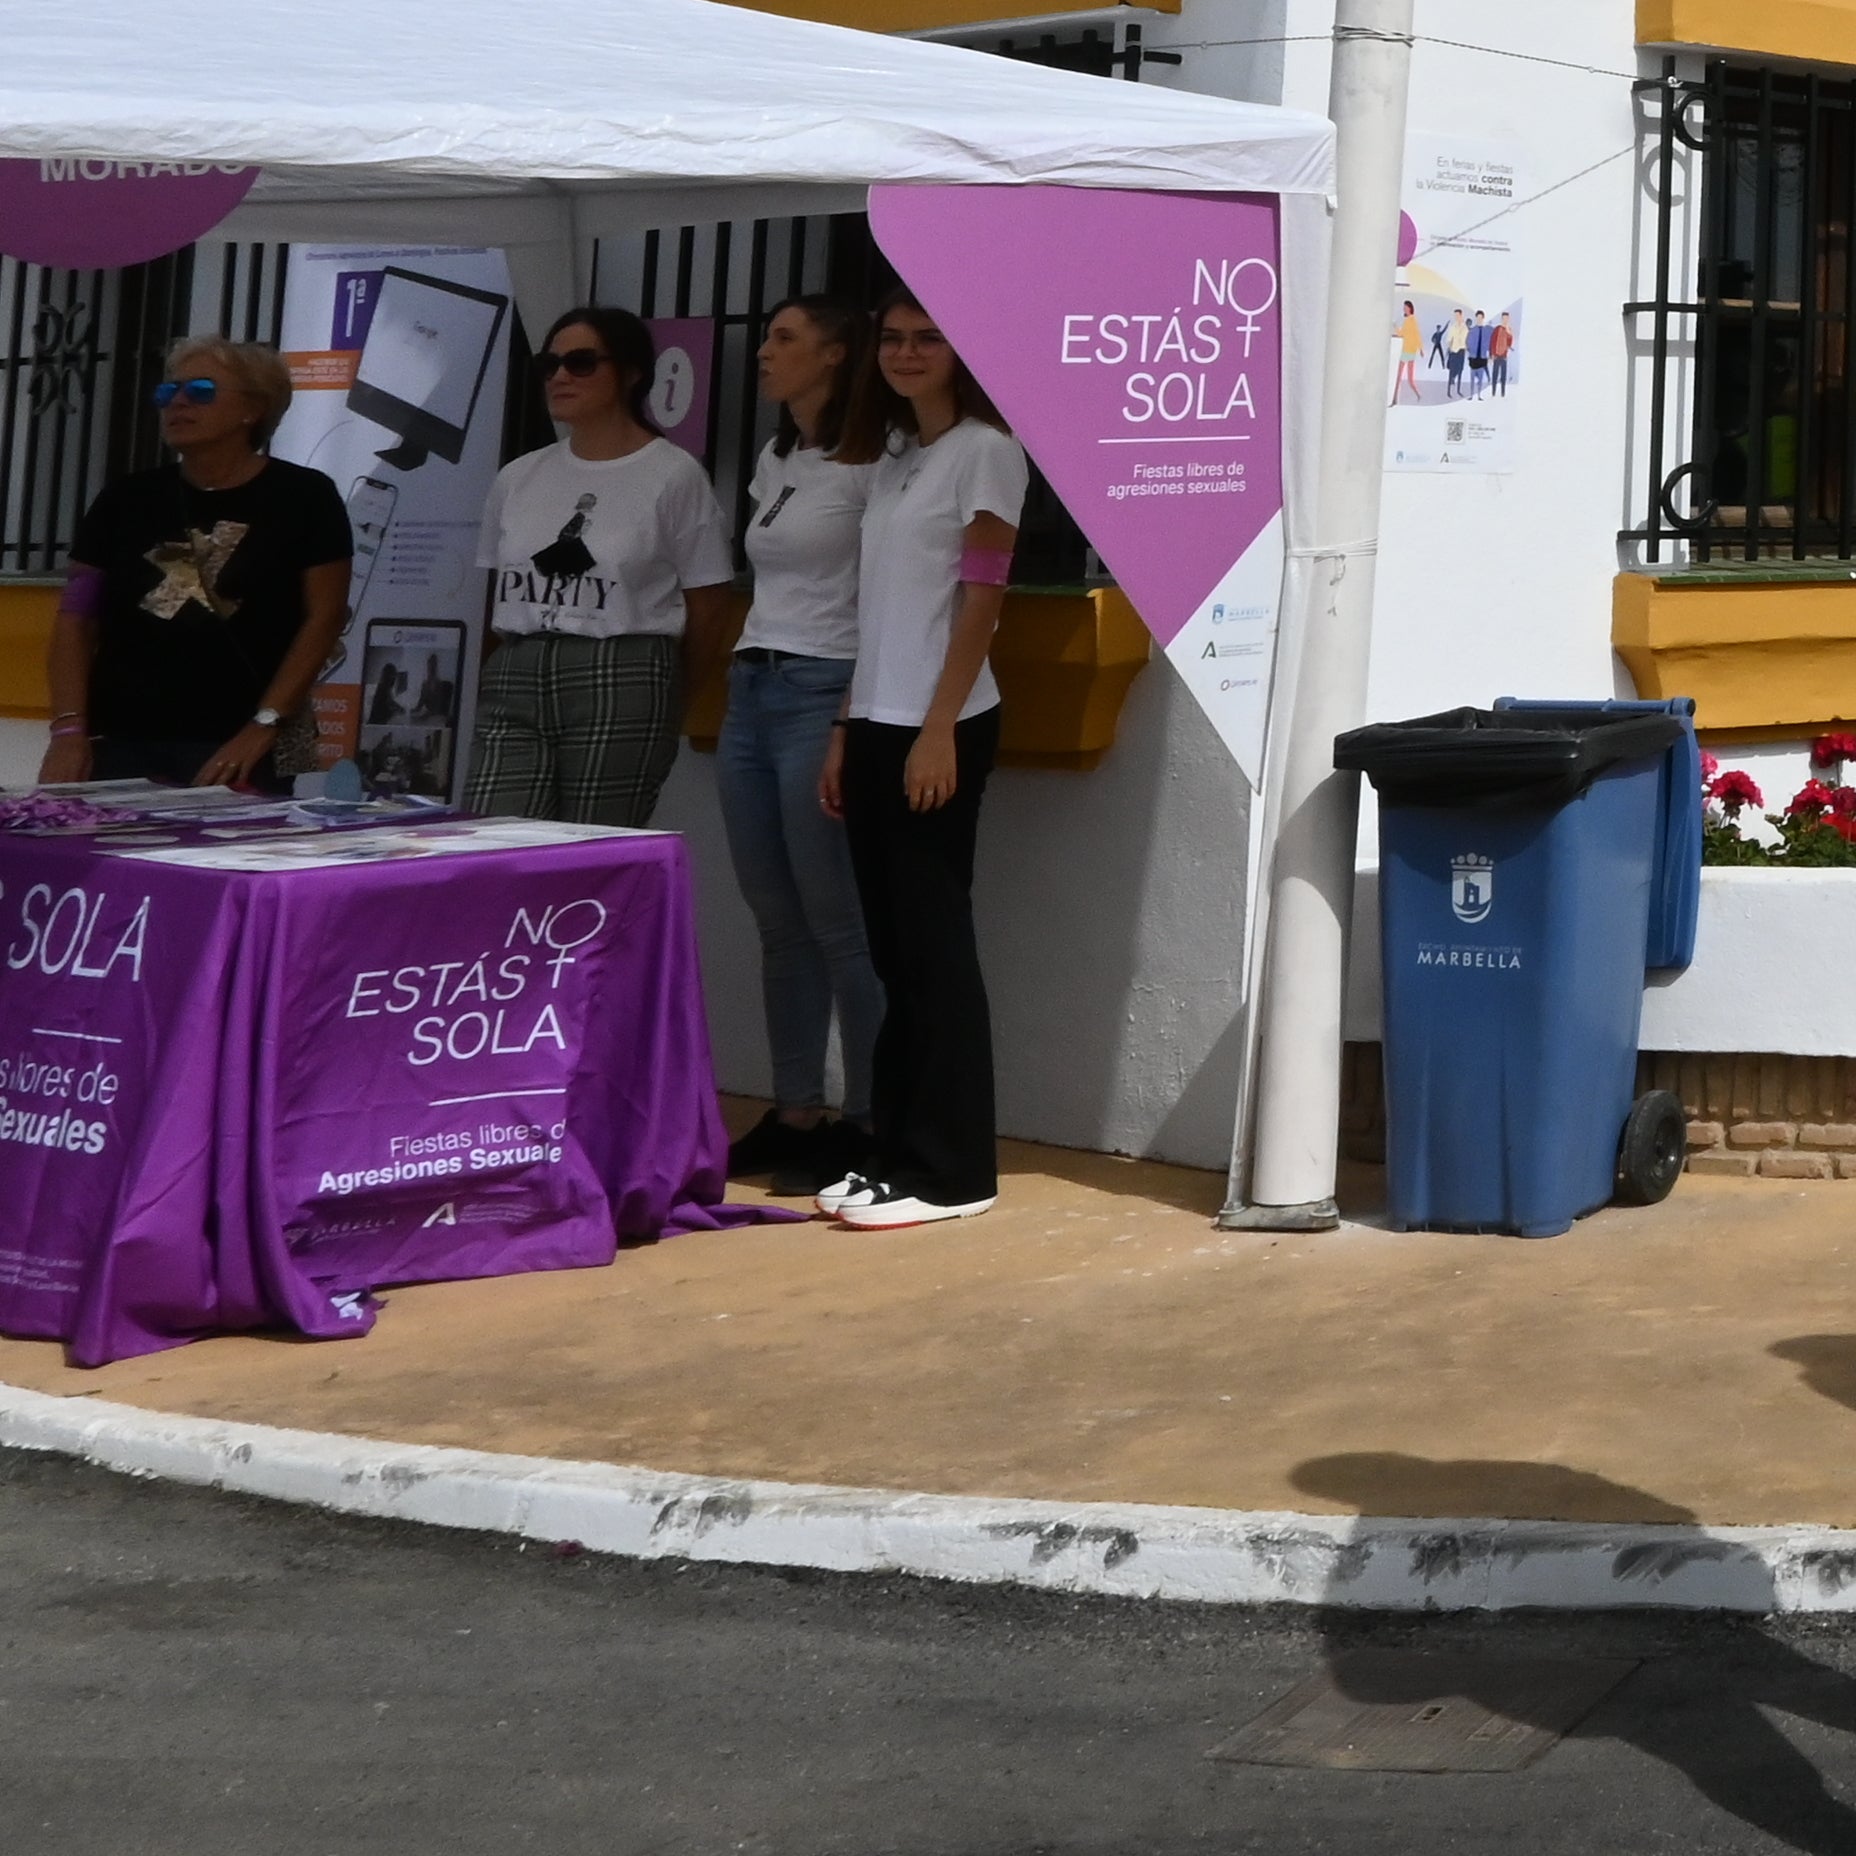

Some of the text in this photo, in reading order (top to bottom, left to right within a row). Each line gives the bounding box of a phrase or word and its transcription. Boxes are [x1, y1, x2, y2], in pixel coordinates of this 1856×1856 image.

[1468, 184, 1513, 197] Machista
[1481, 174, 1513, 186] contra
[1193, 258, 1278, 316] NO
[1061, 307, 1222, 364] ESTÁS
[1122, 372, 1256, 423] SOLA
[1107, 478, 1247, 500] agresiones sexuales
[1133, 461, 1245, 479] Fiestas libres de
[7, 883, 151, 982] SOLA
[504, 899, 608, 949] NO
[346, 951, 531, 1019] ESTÁS
[1416, 951, 1521, 969] MARBELLA
[407, 1003, 566, 1066] SOLA
[77, 1062, 119, 1105] de
[390, 1119, 566, 1158] Fiestas libres d
[318, 1142, 563, 1196] Agresiones Sexuale
